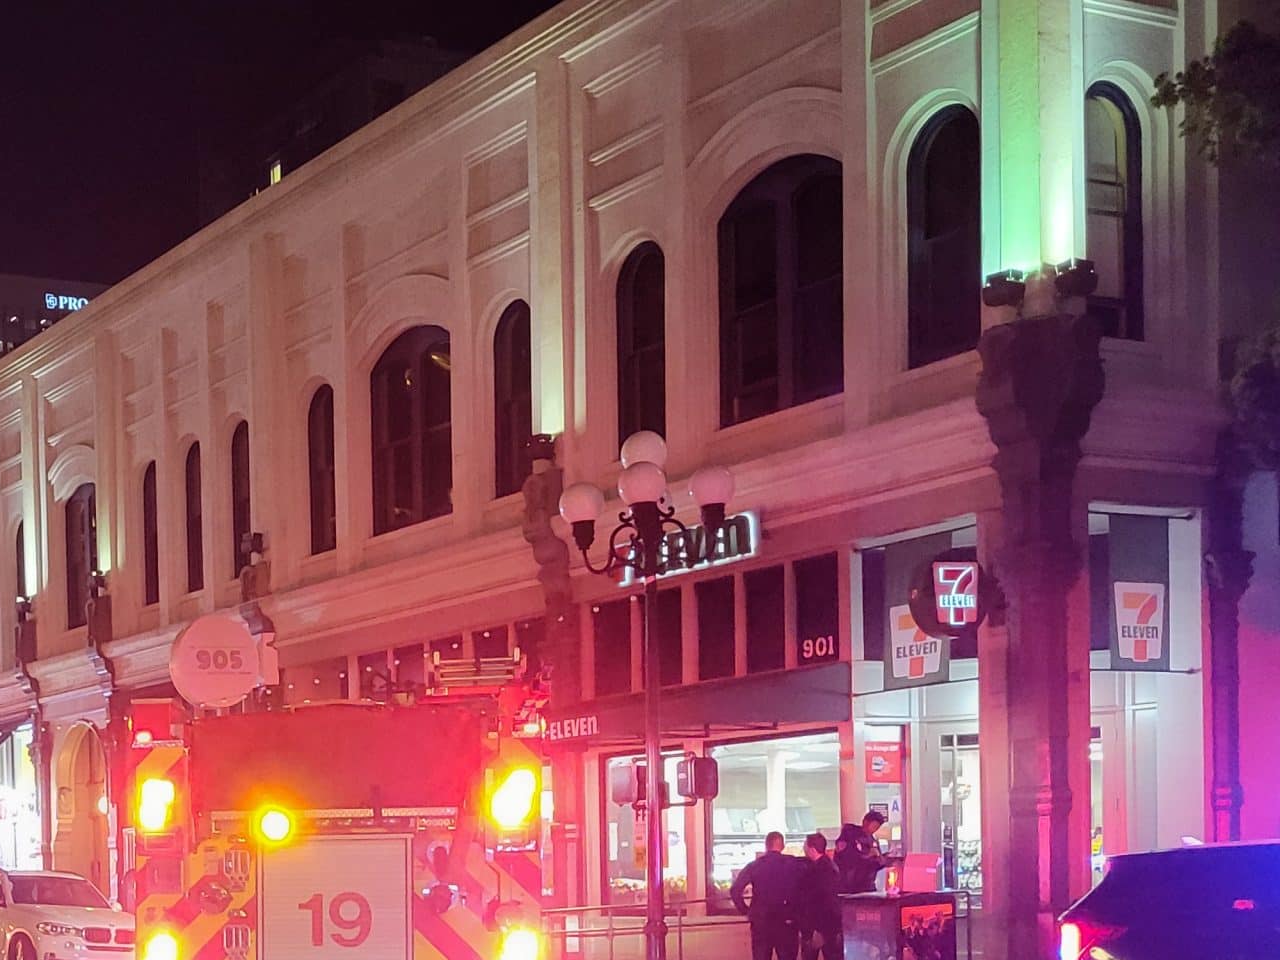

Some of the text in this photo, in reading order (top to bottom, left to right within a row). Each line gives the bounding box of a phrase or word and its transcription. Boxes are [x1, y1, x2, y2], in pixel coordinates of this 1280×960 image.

[58, 295, 89, 311] PRO
[938, 566, 974, 625] 7
[1122, 591, 1158, 661] 7
[196, 649, 243, 670] 905
[803, 635, 835, 658] 901
[298, 891, 372, 948] 19
